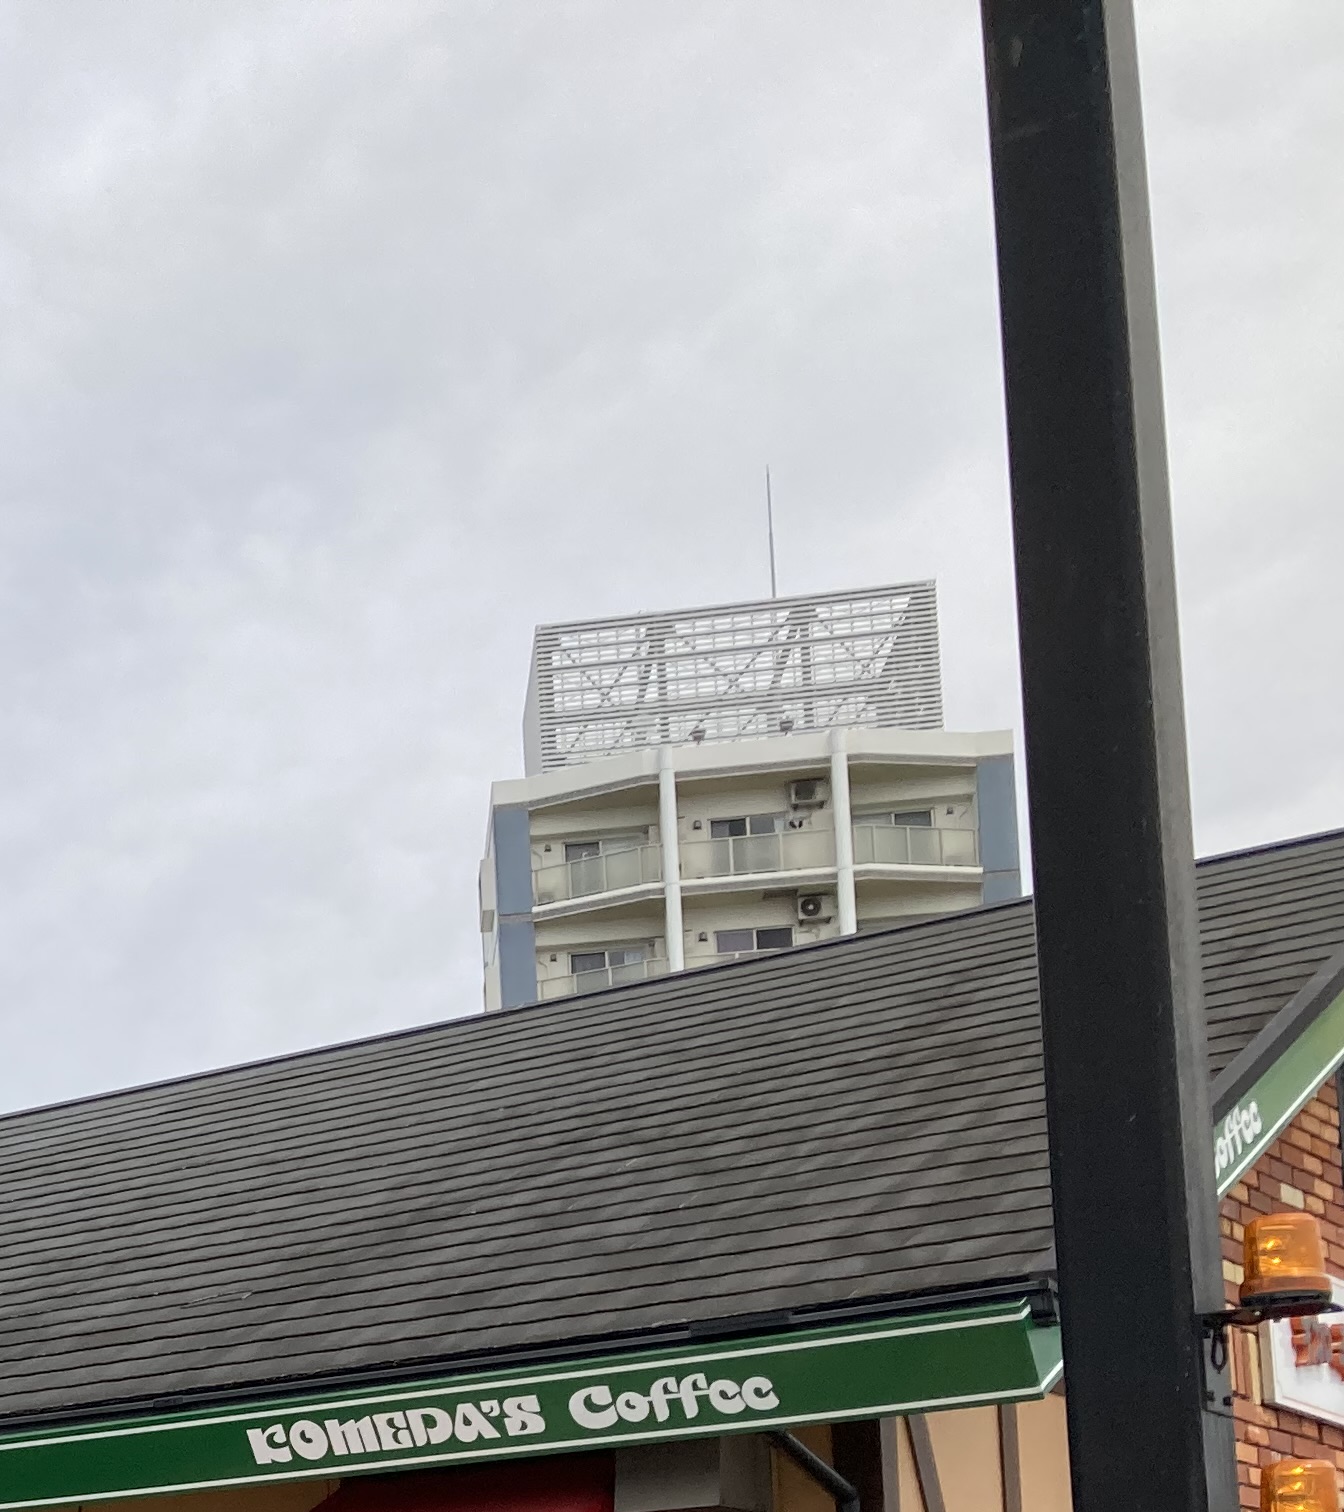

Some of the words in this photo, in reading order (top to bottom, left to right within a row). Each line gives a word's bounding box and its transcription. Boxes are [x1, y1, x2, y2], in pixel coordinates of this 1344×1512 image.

[1214, 1099, 1263, 1179] offee
[246, 1394, 546, 1466] KOMEDA'S
[567, 1372, 781, 1431] Coffee
